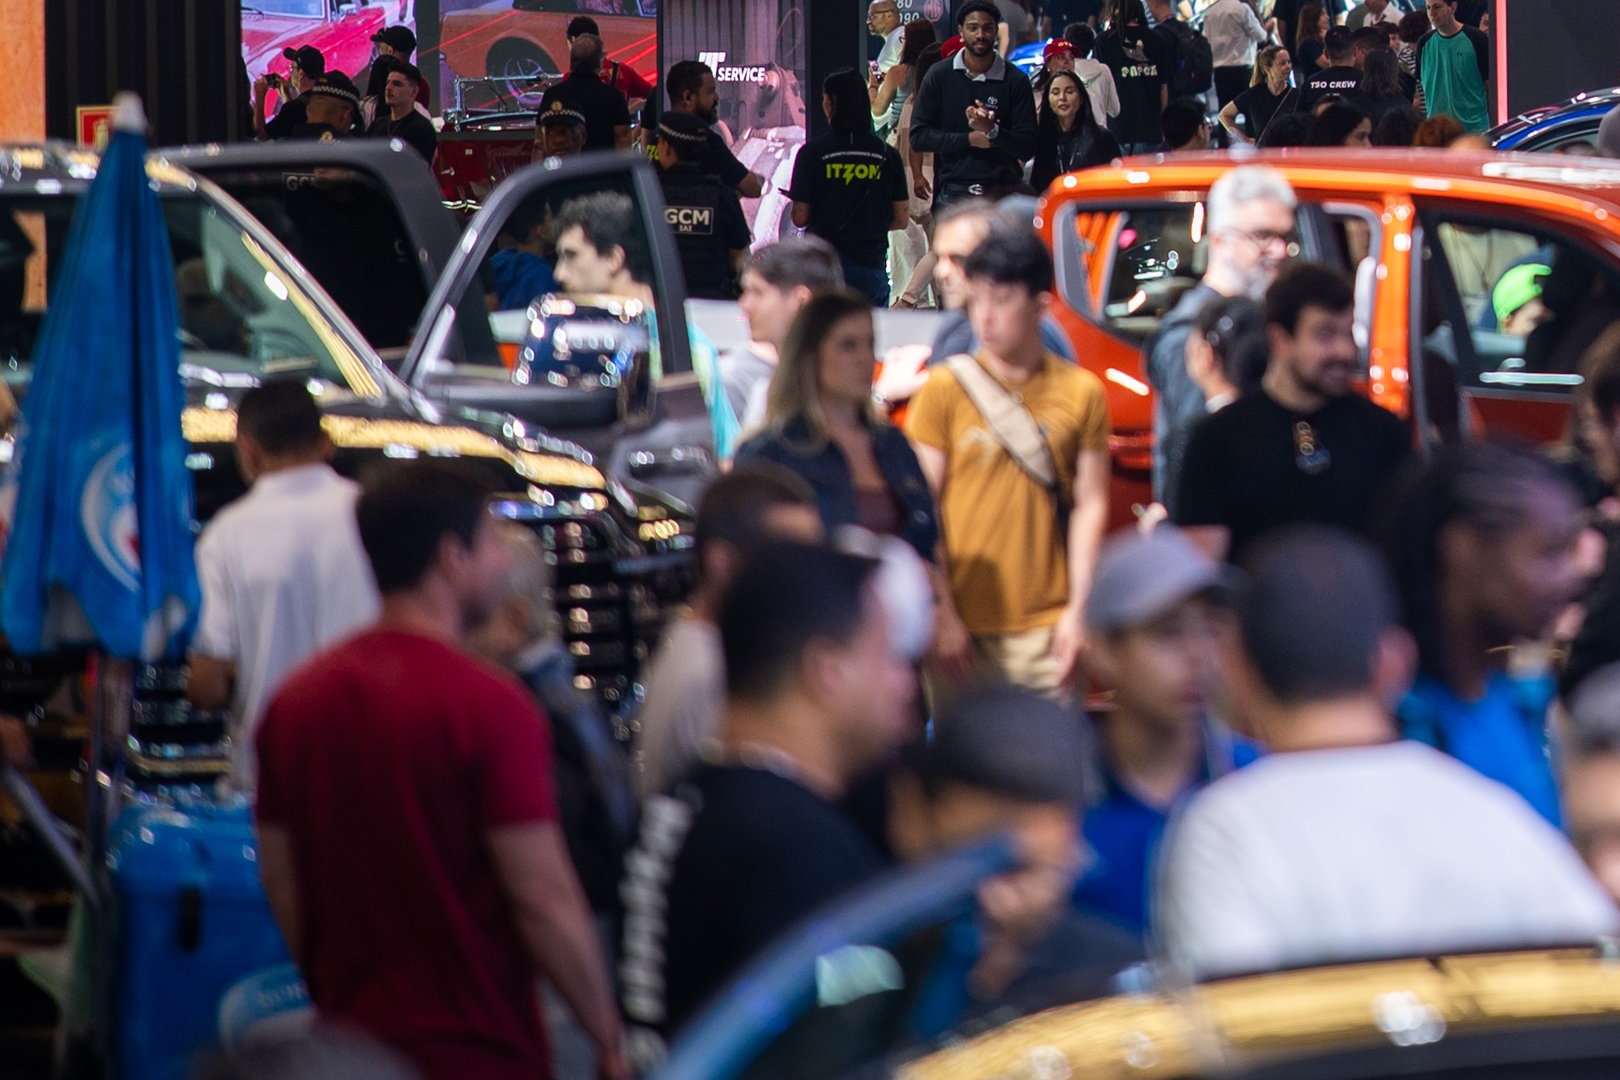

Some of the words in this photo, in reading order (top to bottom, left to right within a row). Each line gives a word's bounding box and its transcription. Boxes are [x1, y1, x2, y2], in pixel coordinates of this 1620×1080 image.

[718, 67, 765, 81] SERVICE
[1310, 81, 1327, 89] TSO
[1329, 81, 1356, 89] CREW
[664, 208, 710, 225] GCM
